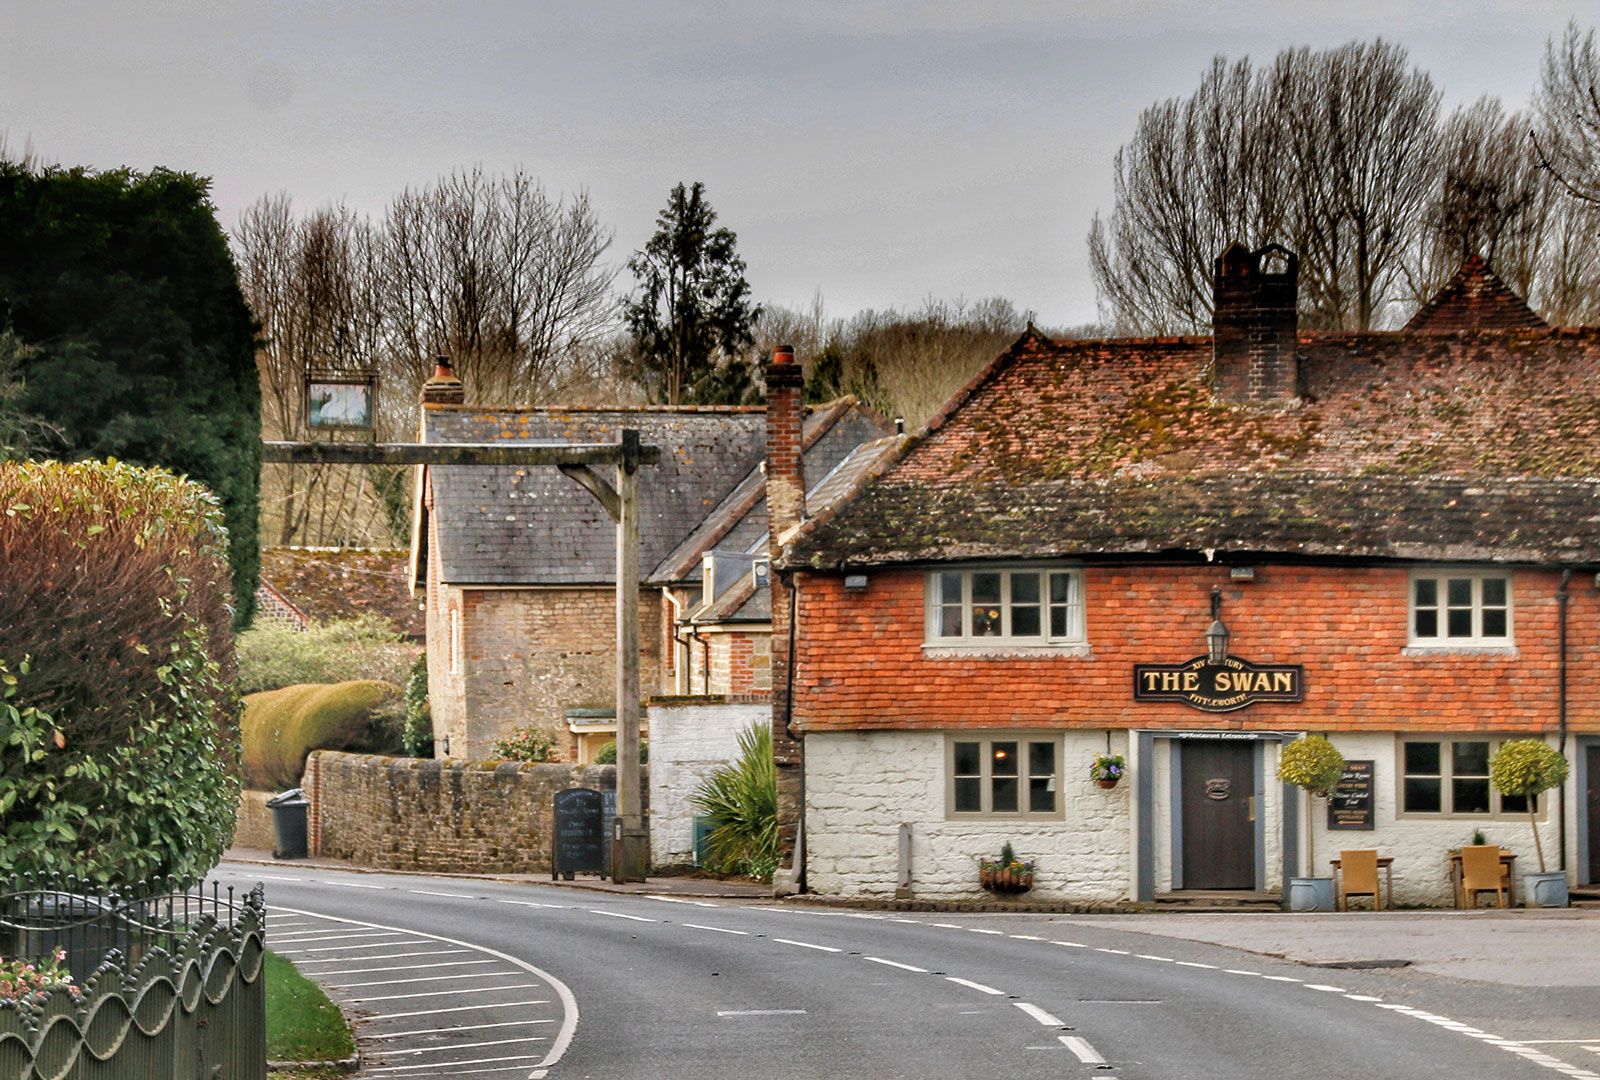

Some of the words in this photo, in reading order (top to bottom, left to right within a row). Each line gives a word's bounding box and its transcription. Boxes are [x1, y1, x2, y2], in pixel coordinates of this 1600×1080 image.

[1192, 659, 1205, 671] XIV
[1207, 658, 1245, 671] CTURY
[1143, 672, 1200, 692] THE
[1214, 672, 1293, 692] SWAN
[1189, 693, 1247, 706] FITTLEWORTH
